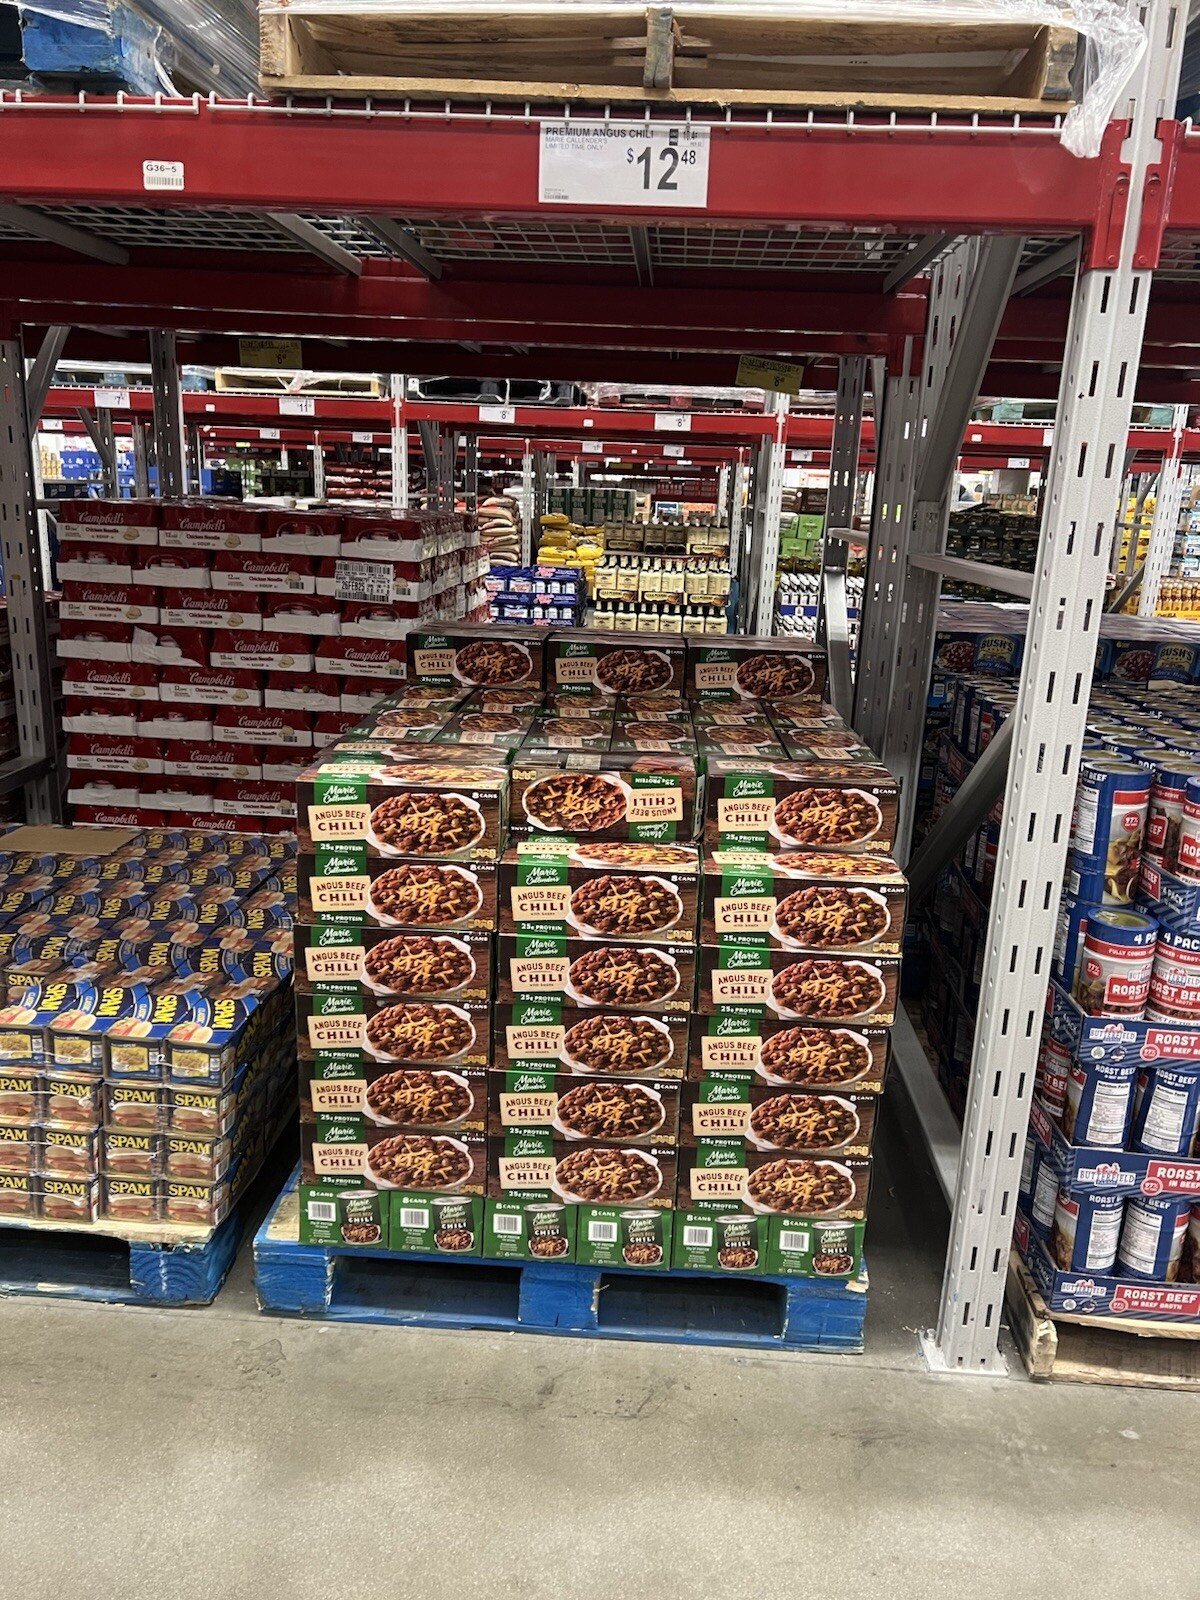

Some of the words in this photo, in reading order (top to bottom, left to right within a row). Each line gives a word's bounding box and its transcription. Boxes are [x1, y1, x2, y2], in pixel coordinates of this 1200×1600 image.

[546, 128, 590, 136] PREMIUM
[593, 129, 626, 137] ANGUS
[629, 130, 654, 138] CHILI
[146, 164, 176, 172] G36-5
[79, 512, 124, 524] Campbell's
[180, 519, 226, 531] Campbell's
[242, 561, 289, 573] Campbell's
[82, 590, 127, 603] Campbell's
[182, 597, 228, 610] Campbell's
[980, 637, 1015, 652] BUSH'S
[345, 648, 390, 661] Campbell's
[1160, 649, 1193, 662] BUSH'S
[87, 670, 130, 683] Campbell's
[190, 672, 235, 686] Campbell's
[238, 716, 283, 727] Campbell's
[90, 743, 134, 755] Campbell's
[1089, 772, 1107, 782] BEEF
[237, 790, 280, 800] Campbell's
[324, 785, 355, 795] Marie
[633, 797, 675, 805] CHILI
[651, 808, 678, 816] ANGUS
[724, 803, 750, 812] ANGUS
[752, 803, 771, 811] BEEF
[95, 813, 137, 824] Campbell's
[315, 811, 344, 820] ANGUS
[345, 810, 366, 819] BEEF
[725, 814, 768, 822] CHILI
[192, 817, 236, 829] Campbell's
[318, 822, 364, 831] CHILI
[1144, 867, 1158, 884] BEEF
[316, 882, 344, 891] ANGUS
[346, 881, 366, 890] BEEF
[732, 878, 763, 888] Marie
[319, 893, 364, 902] CHILI
[517, 891, 545, 901] ANGUS
[547, 892, 567, 901] BEEF
[1163, 885, 1168, 895] 4
[1168, 888, 1184, 906] PACK
[150, 901, 171, 920] SPAM
[520, 902, 564, 911] CHILI
[721, 903, 749, 912] ANGUS
[751, 903, 772, 911] BEEF
[199, 903, 218, 924] SPAM
[247, 909, 264, 929] SPAM
[723, 914, 768, 923] CHILI
[1134, 934, 1143, 944] 4
[1164, 932, 1172, 943] 4
[1174, 935, 1200, 950] PAC
[96, 939, 120, 962] SPAM
[149, 942, 171, 966] SPAM
[200, 947, 220, 972] SPAM
[253, 952, 272, 977] SPAM
[314, 964, 359, 972] CHILI
[519, 974, 563, 983] CHILI
[720, 986, 765, 994] CHILI
[1112, 984, 1145, 995] ROAST
[1151, 982, 1179, 996] OAST
[1180, 990, 1200, 1001] BEE
[38, 983, 67, 1011] SPAM
[97, 987, 124, 1016] SPAM
[152, 995, 178, 1024] SPAM
[214, 999, 235, 1029] SPAM
[317, 1031, 360, 1039] CHILI
[1155, 1034, 1197, 1047] ROAST
[515, 1041, 558, 1049] CHILI
[709, 1053, 754, 1061] CHILI
[324, 1062, 354, 1071] Marie
[1095, 1065, 1119, 1075] ROAST
[1121, 1067, 1136, 1075] BEEF
[1156, 1069, 1178, 1082] ROAST
[49, 1082, 91, 1096] SPAM
[316, 1086, 341, 1094] ANGUS
[344, 1086, 363, 1094] BEEF
[113, 1089, 156, 1103] SPAM
[174, 1094, 217, 1109] SPAM
[319, 1095, 360, 1104] CHILI
[506, 1098, 532, 1107] ANGUS
[534, 1098, 554, 1106] BEEF
[699, 1108, 725, 1117] ANGUS
[727, 1109, 747, 1117] BEEF
[700, 1119, 744, 1127] CHILI
[46, 1132, 87, 1147] SPAM
[109, 1135, 150, 1149] SPAM
[169, 1140, 210, 1155] SPAM
[1079, 1171, 1134, 1183] BUTTERFIELD
[1157, 1167, 1200, 1180] ROAST
[44, 1181, 85, 1195] SPAM
[110, 1181, 151, 1195] SPAM
[698, 1183, 740, 1191] CHILI
[1180, 1181, 1200, 1189] BEEF
[169, 1184, 209, 1199] SPAM
[1089, 1195, 1115, 1203] ROAST
[1149, 1199, 1171, 1209] BEEF
[1062, 1283, 1105, 1295] BUTTERFIELD
[1123, 1289, 1161, 1302] ROAST
[1167, 1290, 1197, 1303] BEEF
[1160, 1302, 1183, 1310] BROTH
